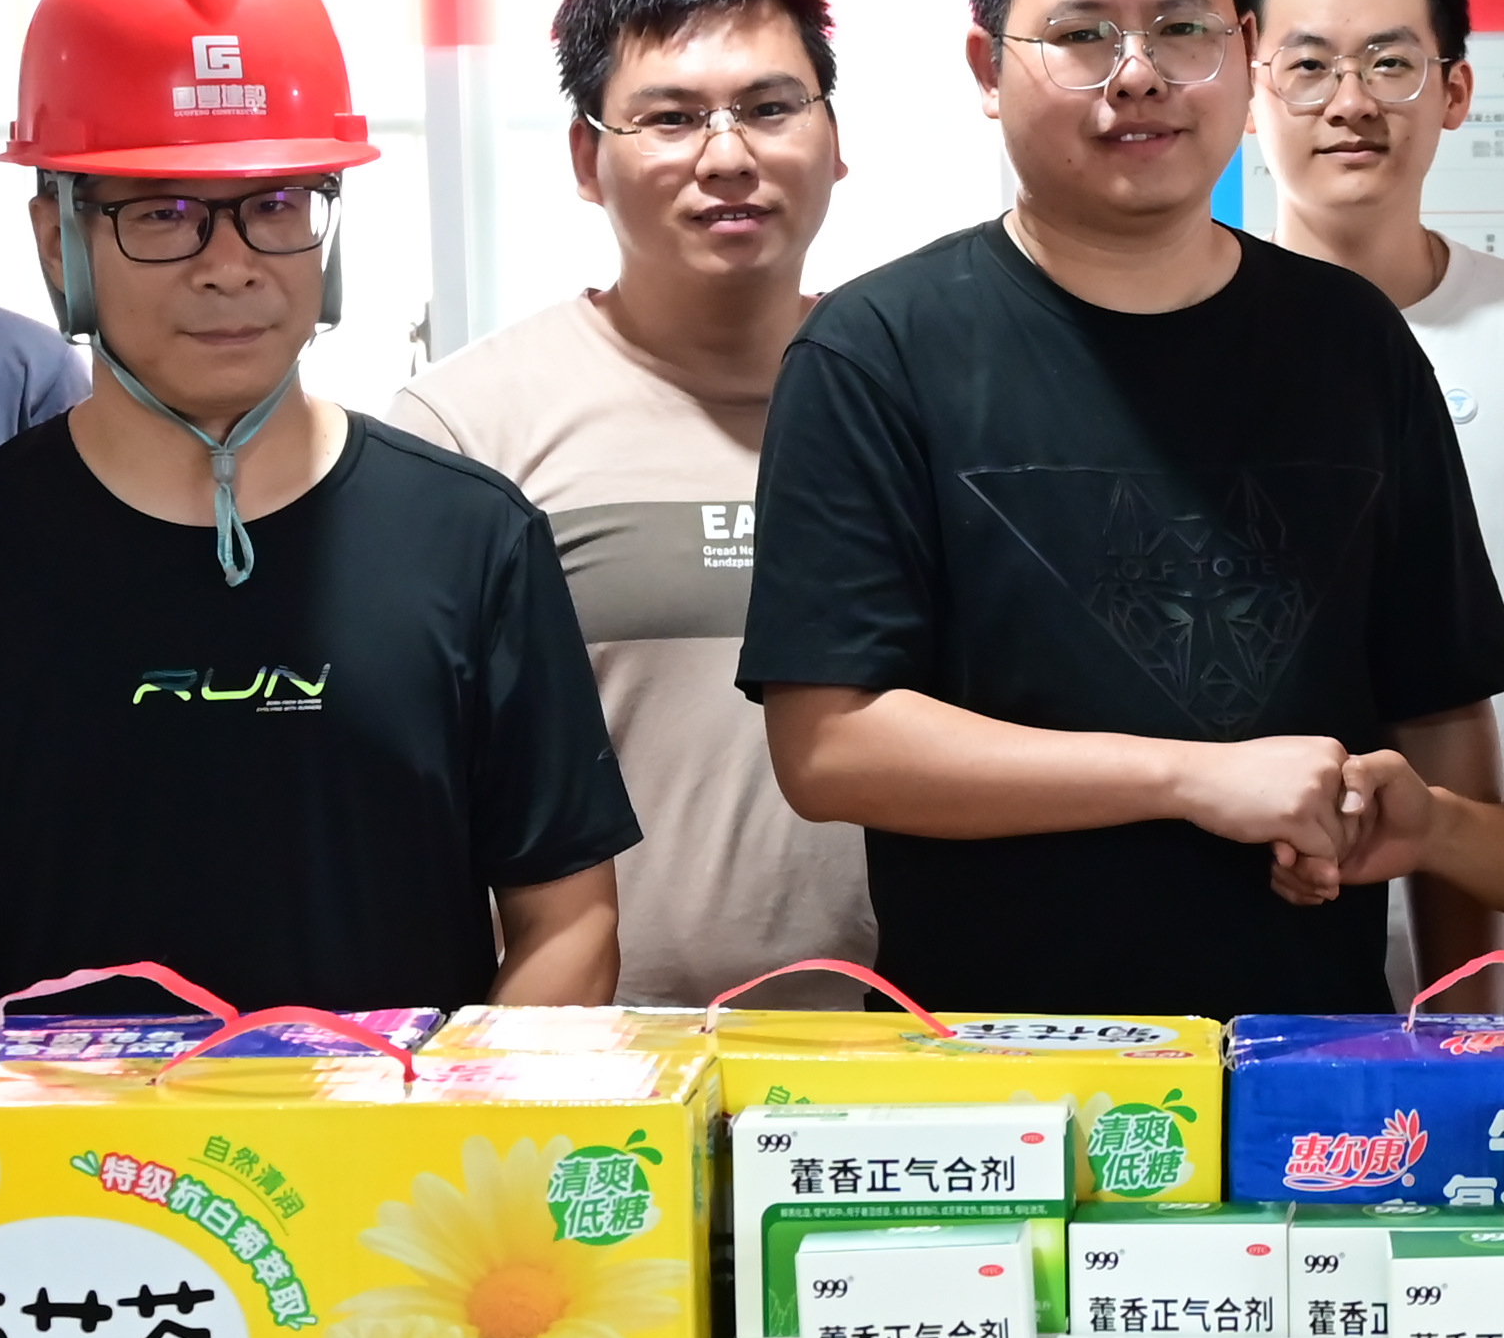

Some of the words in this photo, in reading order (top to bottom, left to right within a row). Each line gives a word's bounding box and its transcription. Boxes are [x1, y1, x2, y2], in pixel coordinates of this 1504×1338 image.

[132, 663, 331, 704] RUN
[758, 1134, 791, 1152] 999
[1089, 1114, 1171, 1155] 清爽
[791, 1156, 1014, 1194] 藿香正气合剂
[1103, 1148, 1185, 1190] 低糖
[1286, 1133, 1406, 1178] 惠尔康
[203, 1135, 304, 1219] 自然清润
[548, 1155, 631, 1200] 清爽
[564, 1192, 650, 1239] 低糖
[1085, 1252, 1118, 1269] 999
[1305, 1255, 1338, 1273] 999
[813, 1280, 847, 1298] 999
[1406, 1287, 1441, 1305] 999
[1090, 1297, 1272, 1332] 藿香正气合剂
